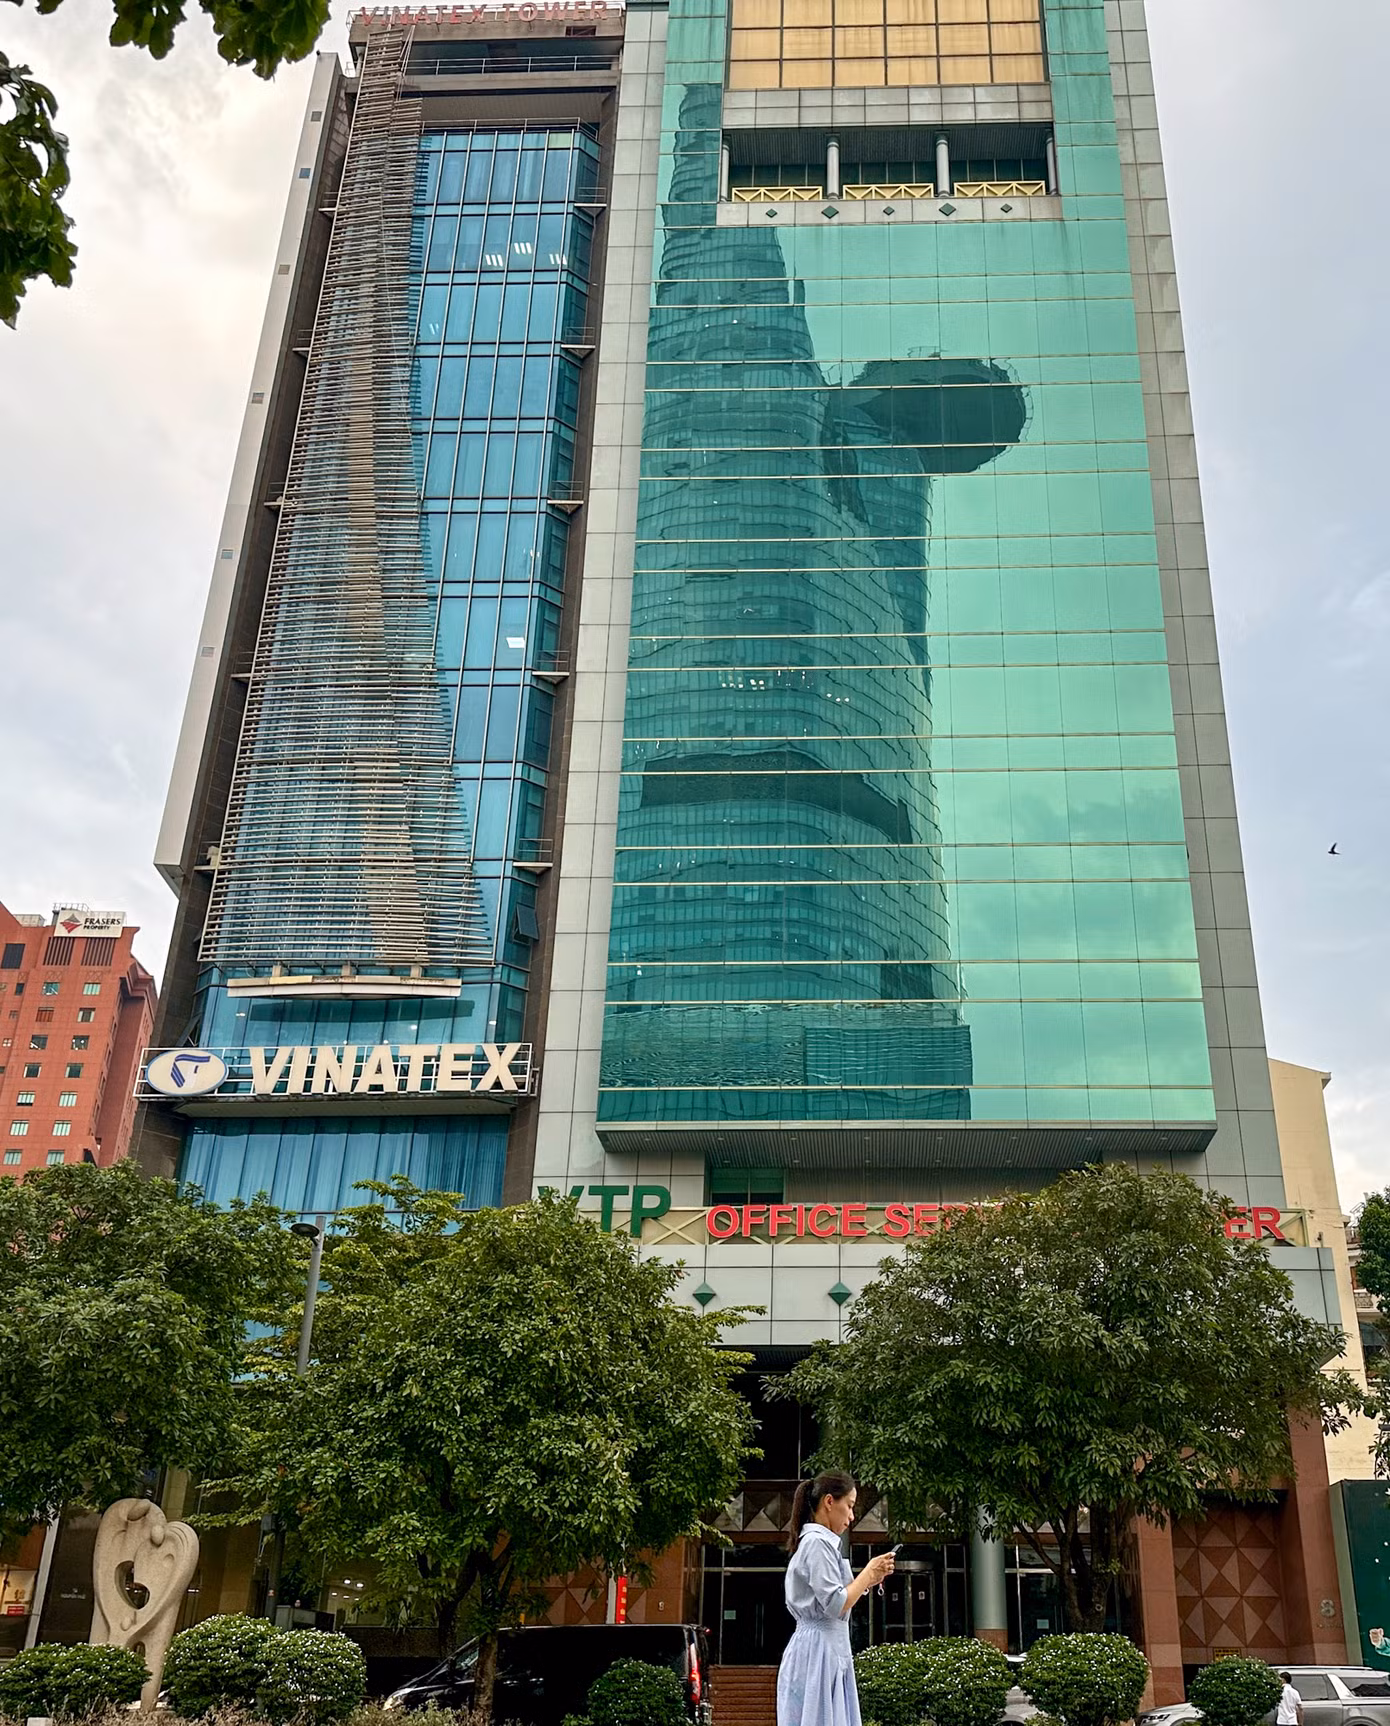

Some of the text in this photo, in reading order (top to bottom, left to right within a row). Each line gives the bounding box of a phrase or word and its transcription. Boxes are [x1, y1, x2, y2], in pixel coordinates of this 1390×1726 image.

[360, 1, 608, 26] VINATEX TOWER
[84, 917, 121, 926] FRASERS
[249, 1043, 521, 1094] VINATEX
[706, 1204, 868, 1238] OFFICE
